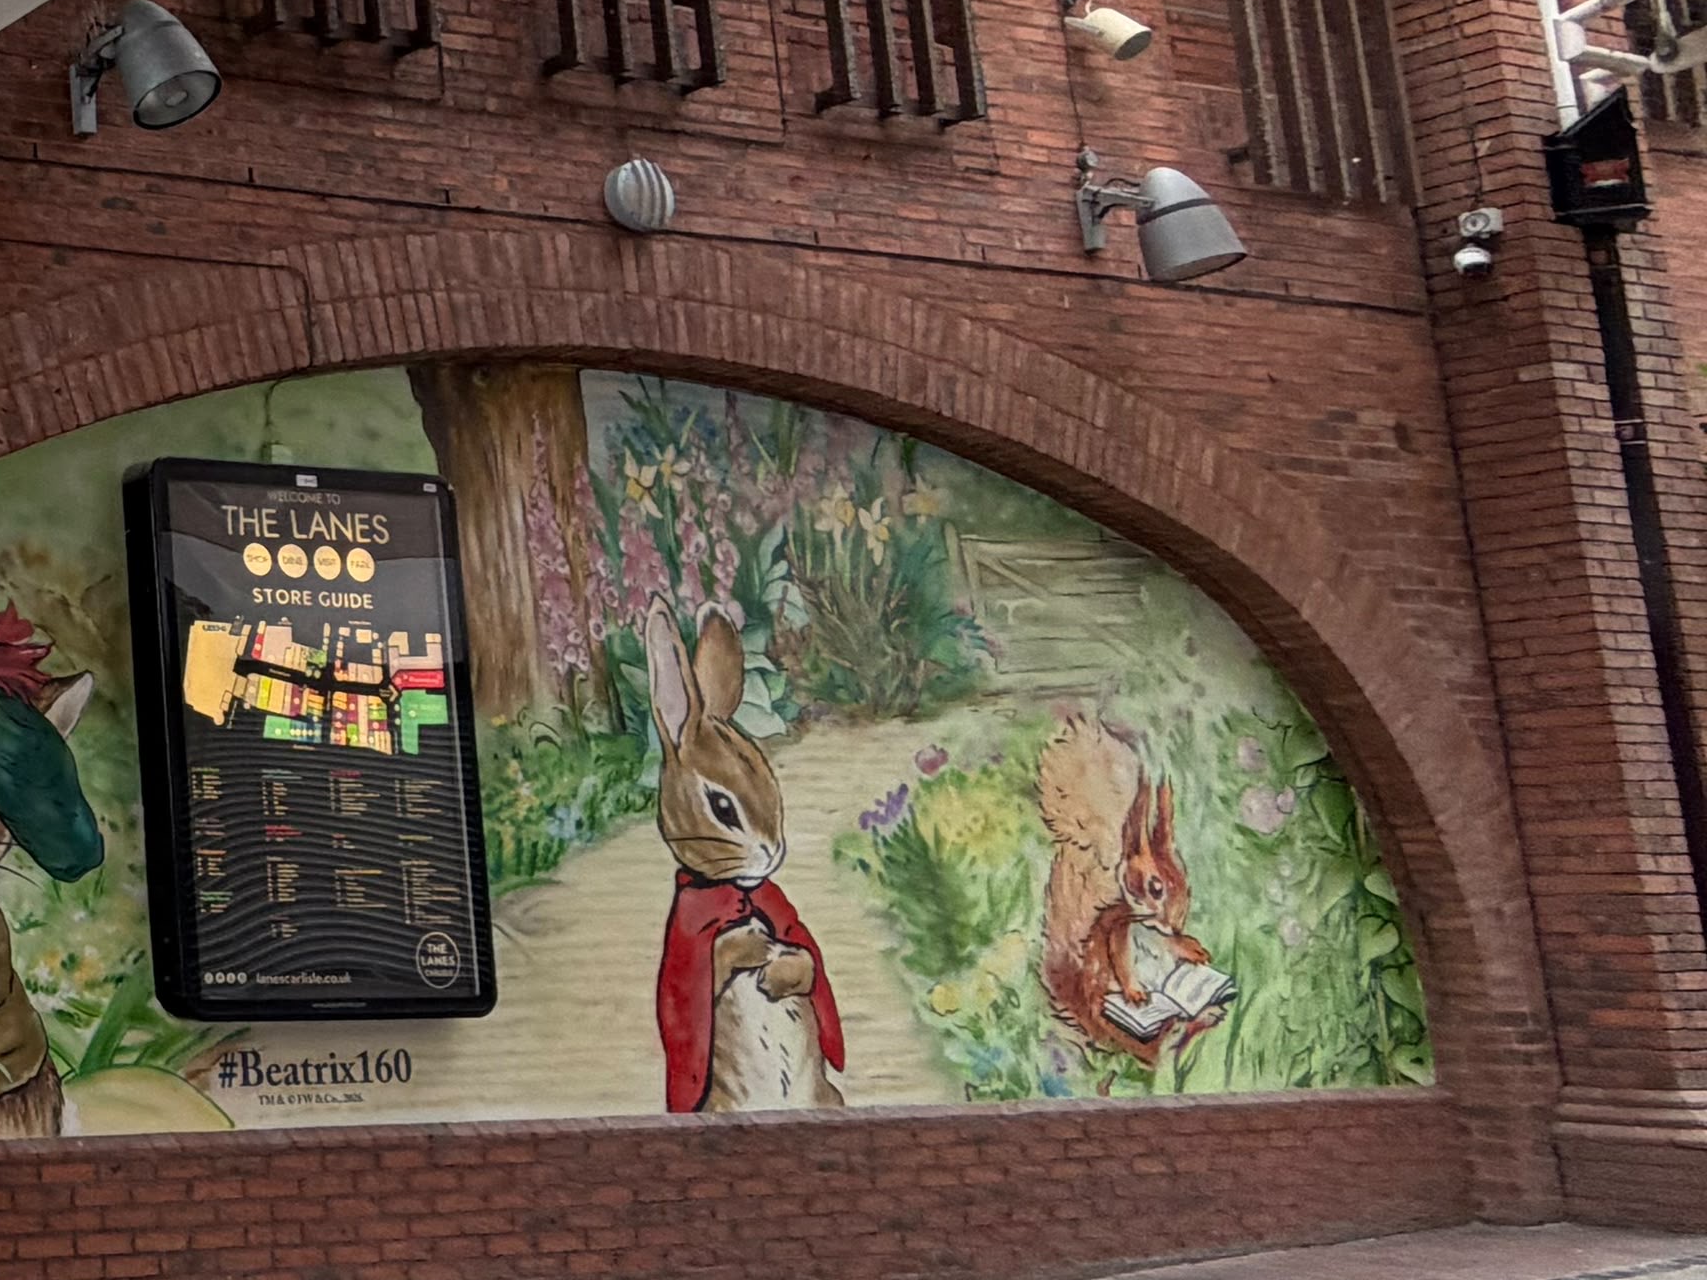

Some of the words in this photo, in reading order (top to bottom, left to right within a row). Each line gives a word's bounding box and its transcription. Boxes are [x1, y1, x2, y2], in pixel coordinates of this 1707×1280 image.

[267, 490, 324, 505] WELCOME
[327, 493, 341, 505] TO
[221, 505, 280, 538] THE
[290, 508, 390, 544] LANES
[253, 587, 313, 606] STORE
[318, 591, 374, 610] GUIDE
[426, 943, 447, 954] THE
[420, 955, 455, 966] LANES
[256, 971, 352, 985] lanescarlisle.co.uk
[218, 1048, 413, 1088] #Beatrix160
